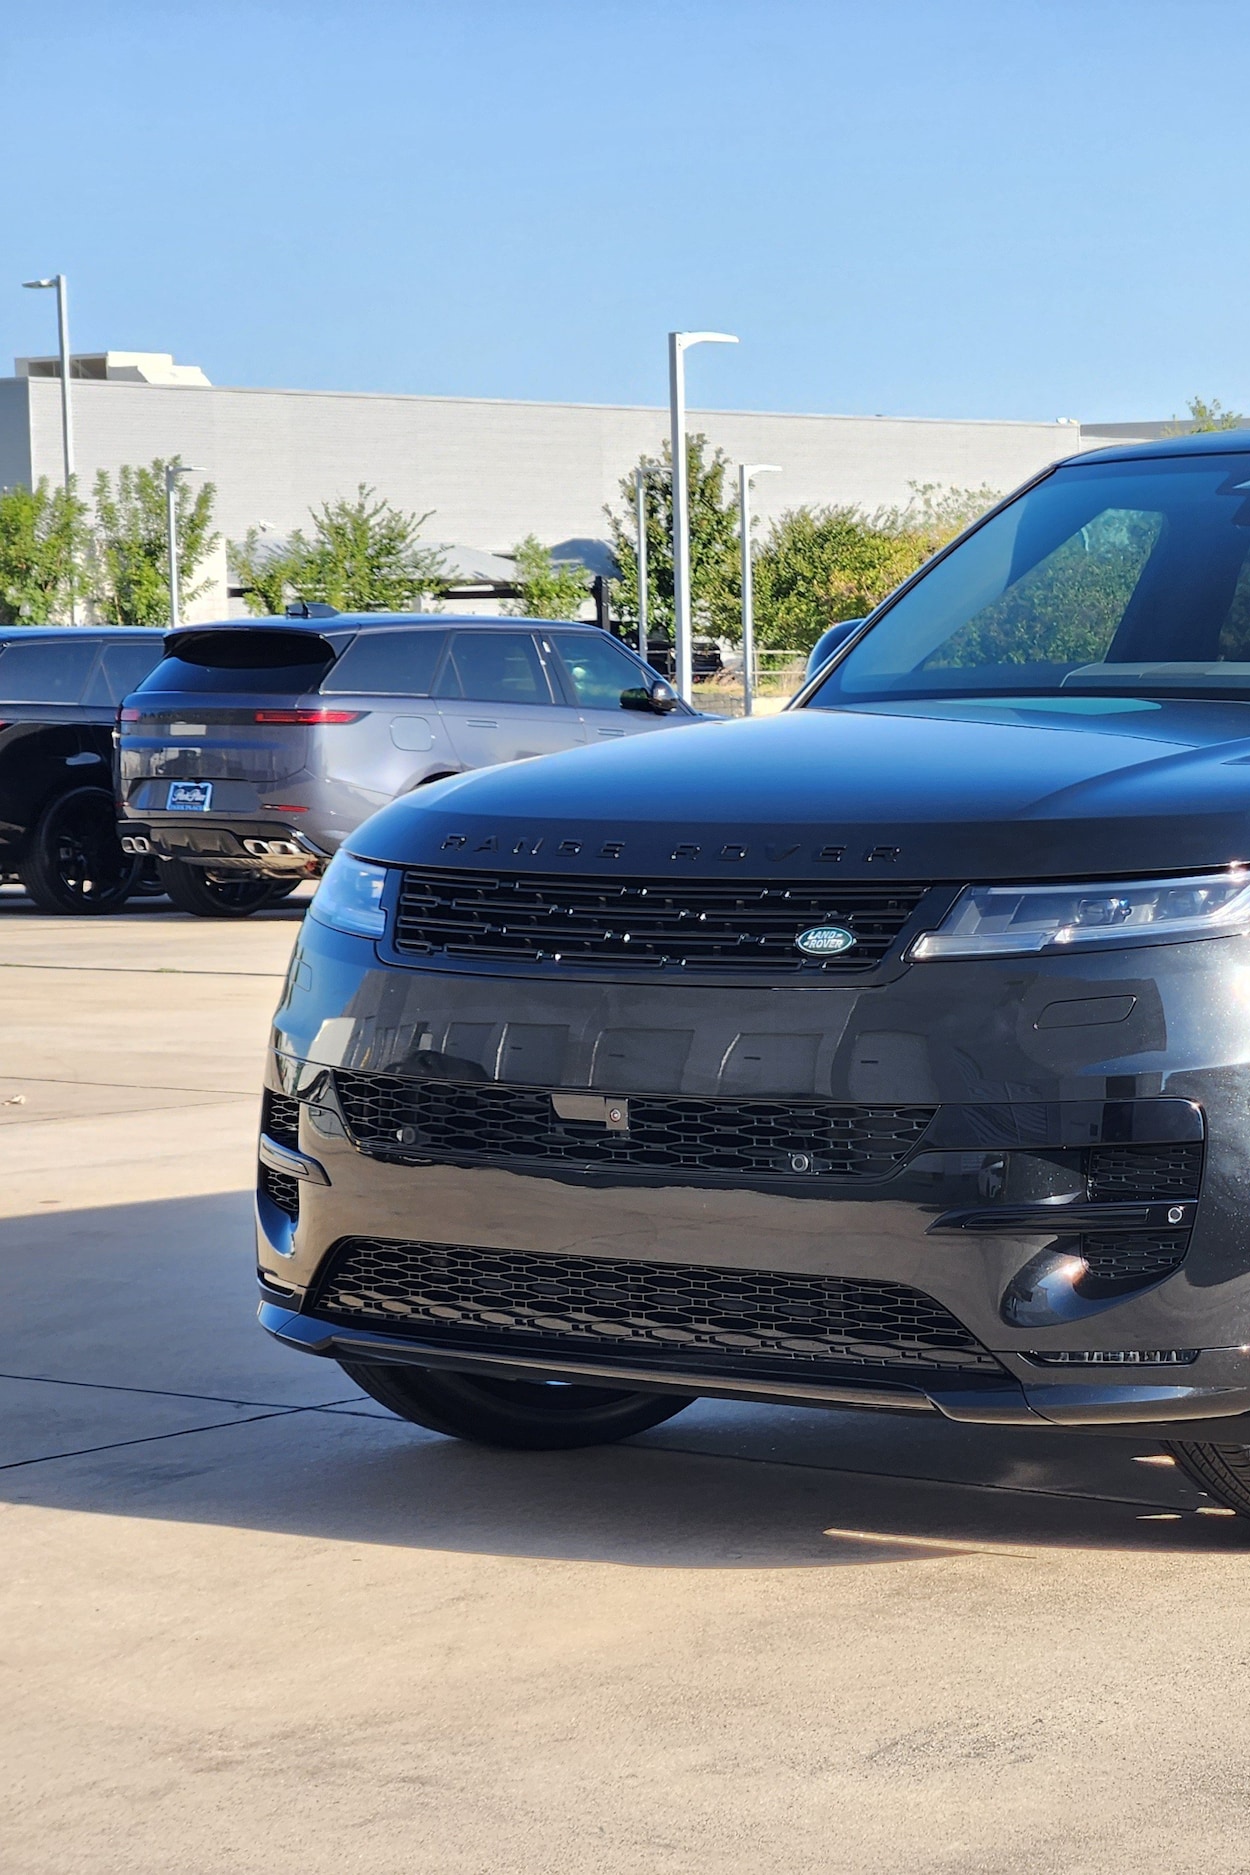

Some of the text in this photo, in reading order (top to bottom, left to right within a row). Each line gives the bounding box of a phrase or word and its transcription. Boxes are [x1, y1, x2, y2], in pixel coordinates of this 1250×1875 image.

[440, 833, 902, 862] RANGE ROVER
[807, 930, 836, 940] LAND
[808, 939, 844, 949] ROVER
